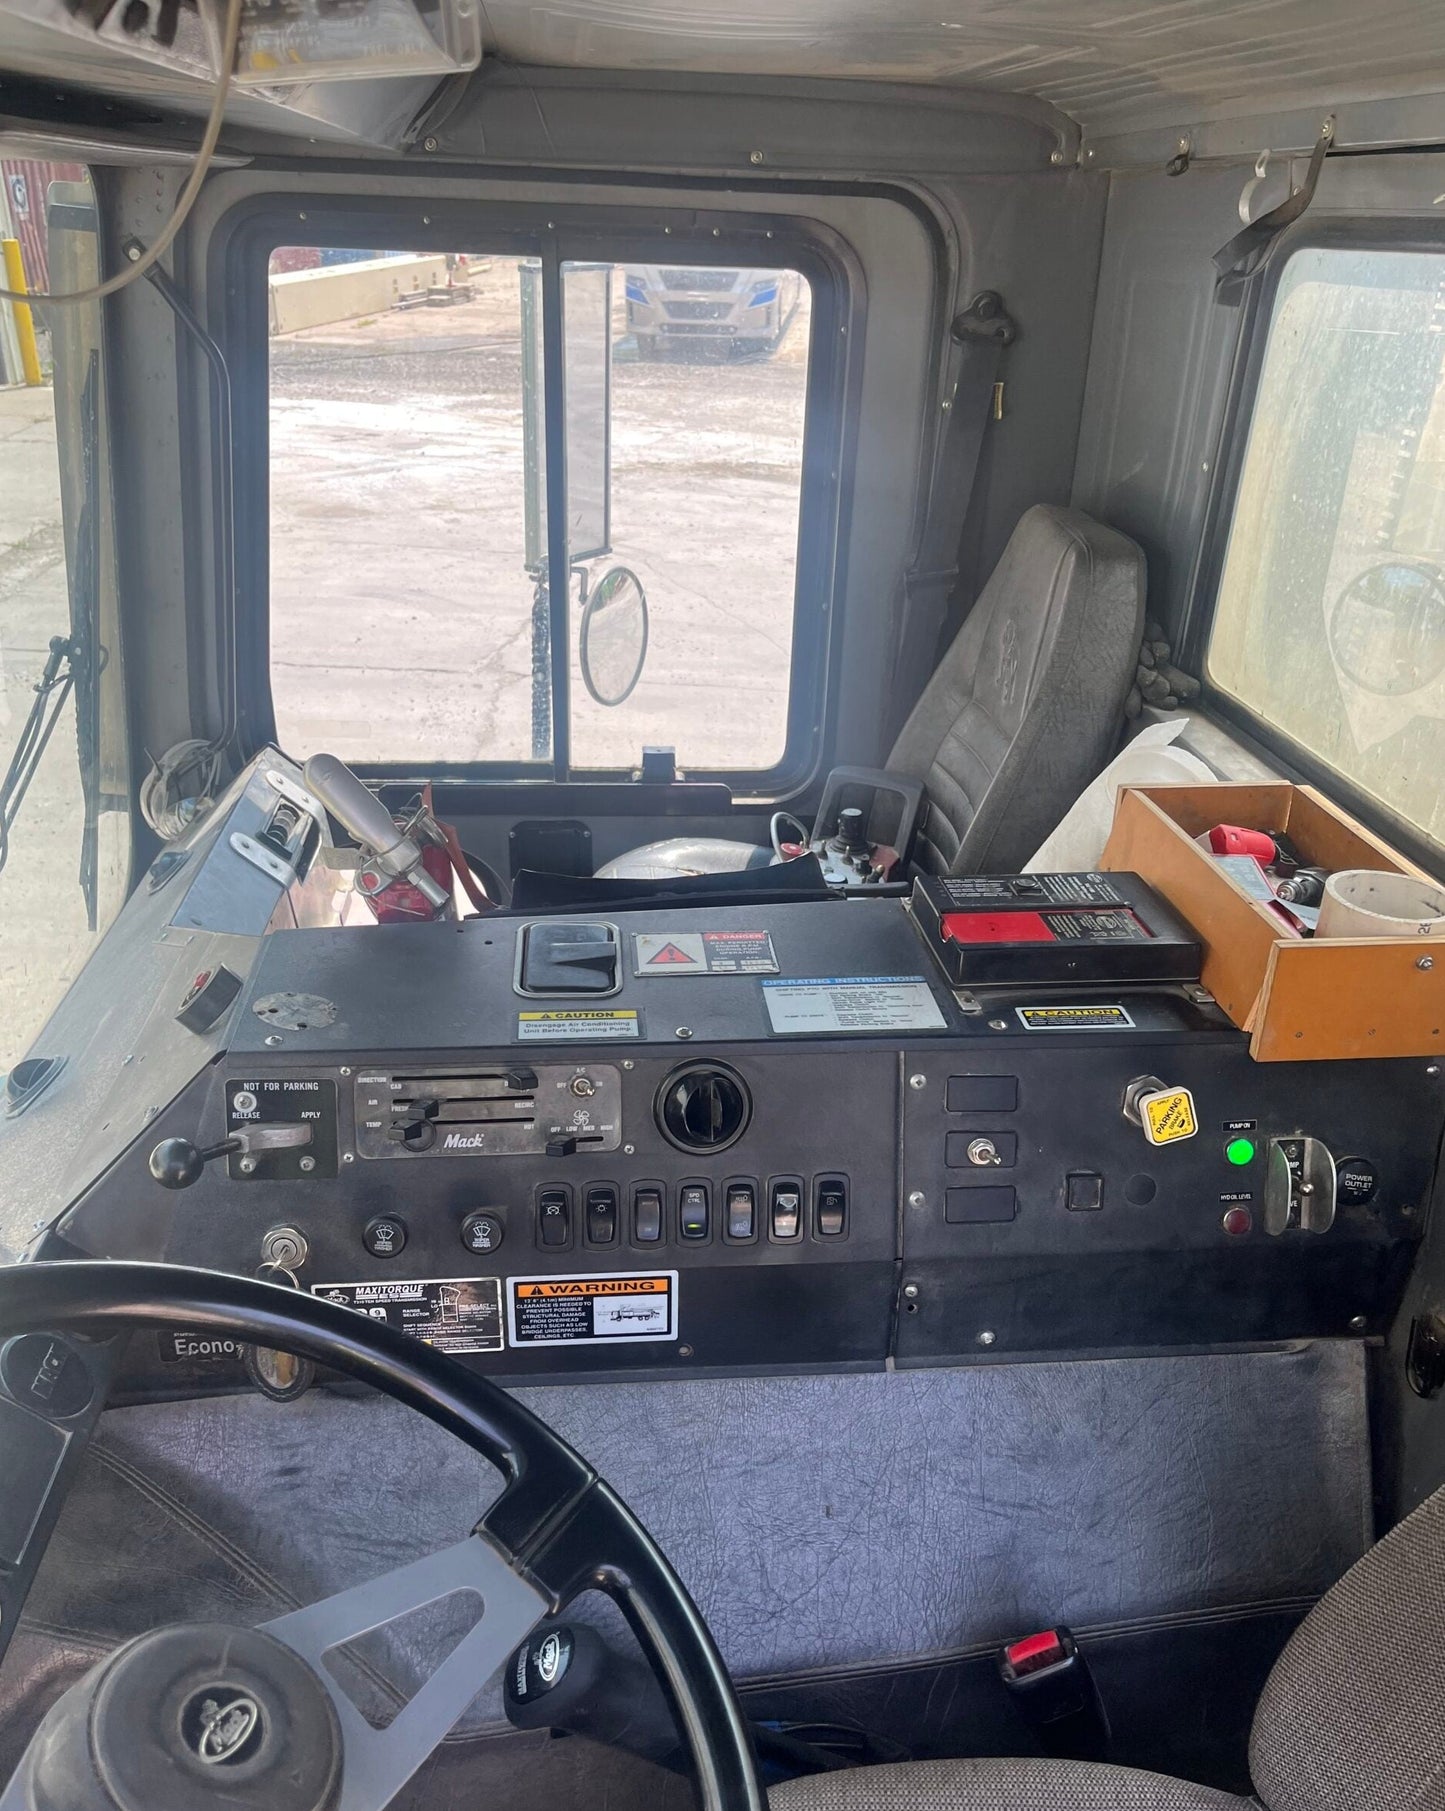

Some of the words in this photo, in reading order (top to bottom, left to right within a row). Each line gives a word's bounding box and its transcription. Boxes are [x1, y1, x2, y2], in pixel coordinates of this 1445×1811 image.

[834, 976, 924, 984] INSTRUCTIONS
[244, 1083, 260, 1091] NOT
[264, 1083, 280, 1091] FOR
[284, 1082, 319, 1091] PARKING
[1156, 1097, 1183, 1135] PARKING
[1169, 1111, 1182, 1130] BRAKE
[1346, 1174, 1373, 1182] POWER
[1345, 1181, 1372, 1189] OUTLET
[356, 1284, 425, 1296] MAXITORQUE
[549, 1282, 656, 1294] WARNING
[174, 1338, 235, 1356] Econo
